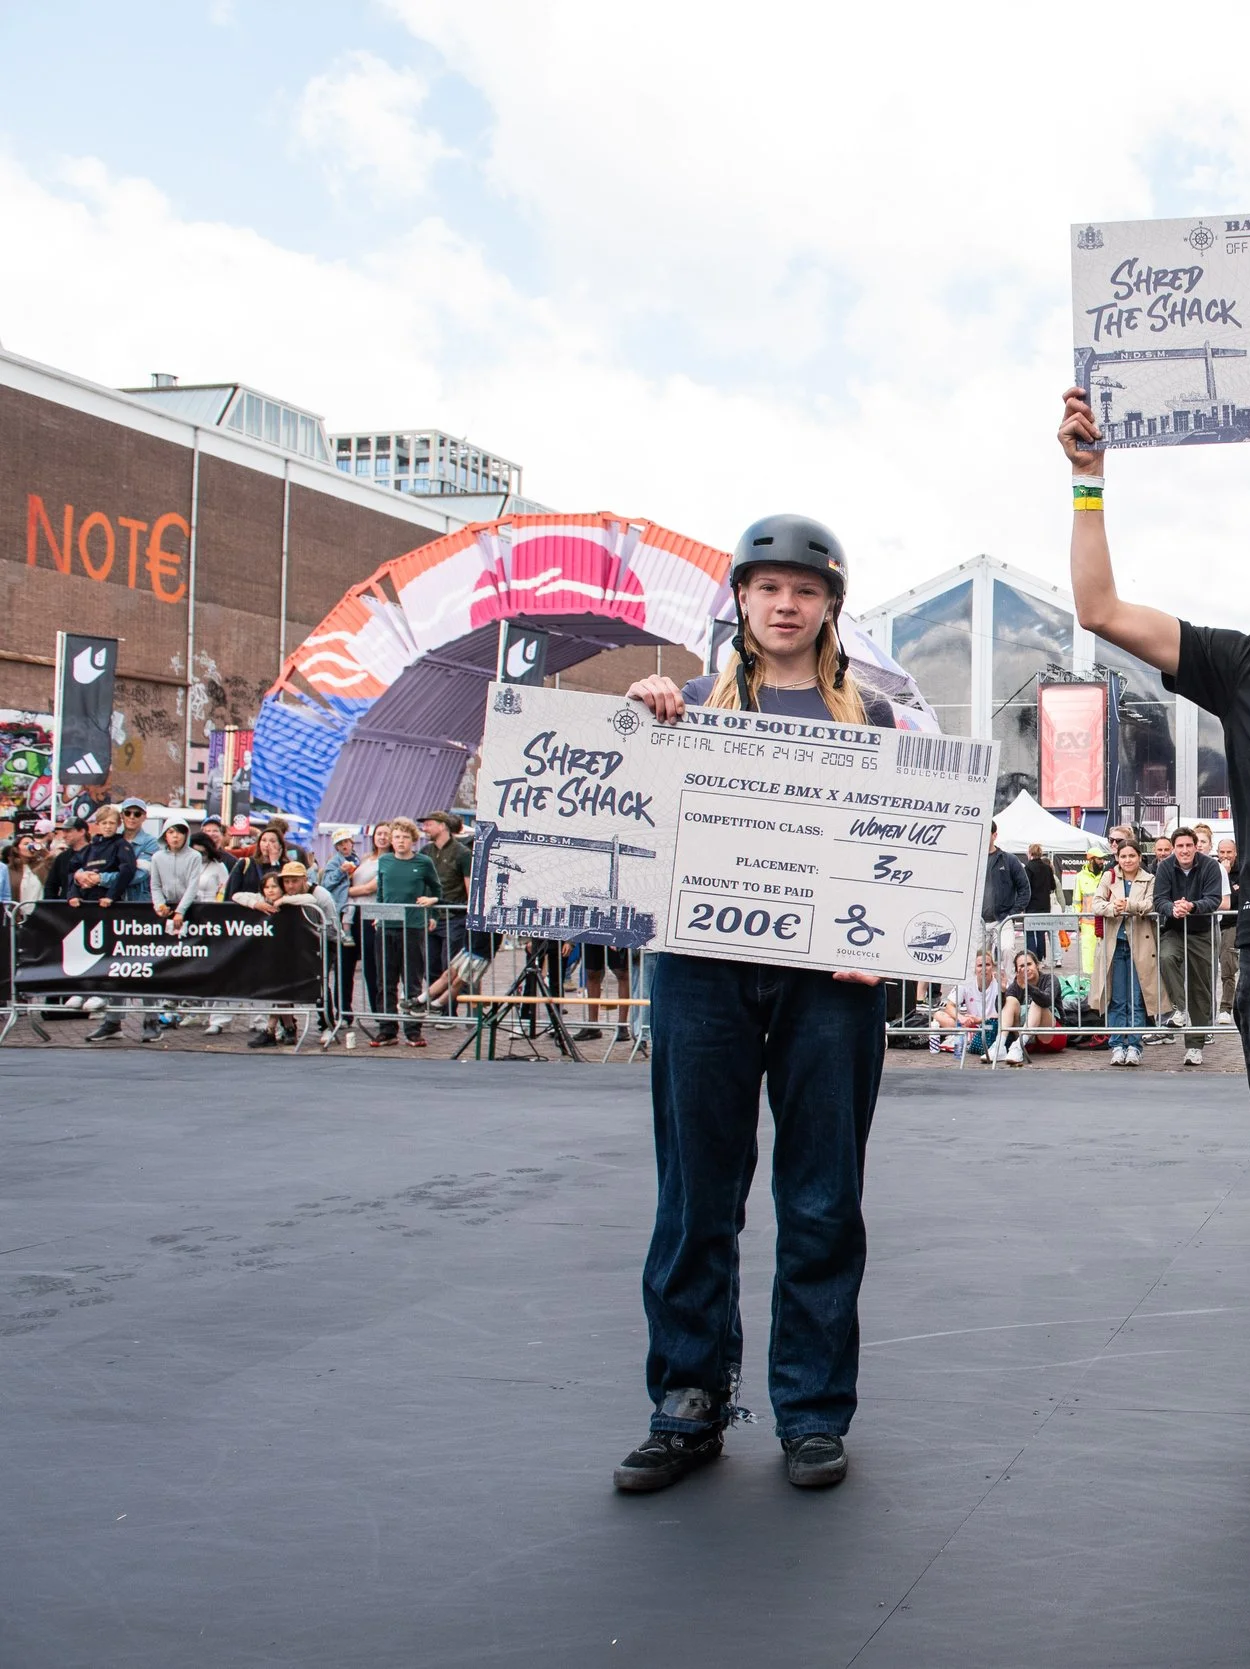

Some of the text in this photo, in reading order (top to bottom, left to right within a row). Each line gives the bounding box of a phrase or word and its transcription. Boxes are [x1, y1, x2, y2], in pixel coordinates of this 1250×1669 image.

[1110, 257, 1204, 300] SHRED
[1085, 293, 1243, 342] THE SHACK
[1120, 351, 1169, 360] N.D.S.M.
[722, 715, 752, 730] OF
[754, 719, 881, 746] SOULCYCLE
[523, 731, 624, 780] SHRED
[649, 731, 715, 752] OFFICIAL
[723, 739, 765, 757] CHECK
[820, 751, 854, 768] 2009
[860, 755, 878, 770] 65
[895, 763, 989, 783] SOULCYCLE BMX
[493, 776, 656, 828] THE SHACK
[683, 772, 980, 817] SOULCYCLE BMX X AMSTERDAM 750
[683, 811, 824, 836] COMPETITION CLASS:
[848, 815, 947, 846] WOMEN UCI
[524, 833, 575, 845] N.D.S.M.
[735, 856, 819, 875] PLACEMENT:
[873, 854, 913, 884] 3RD
[681, 874, 814, 898] AMOUNT TO BE PAID
[112, 918, 274, 937] Urban orts Week
[687, 902, 801, 940] 200€
[112, 941, 209, 957] Amsterdam
[836, 947, 880, 958] SOULCYCLE
[912, 950, 943, 963] NDSM
[108, 962, 153, 978] 2025
